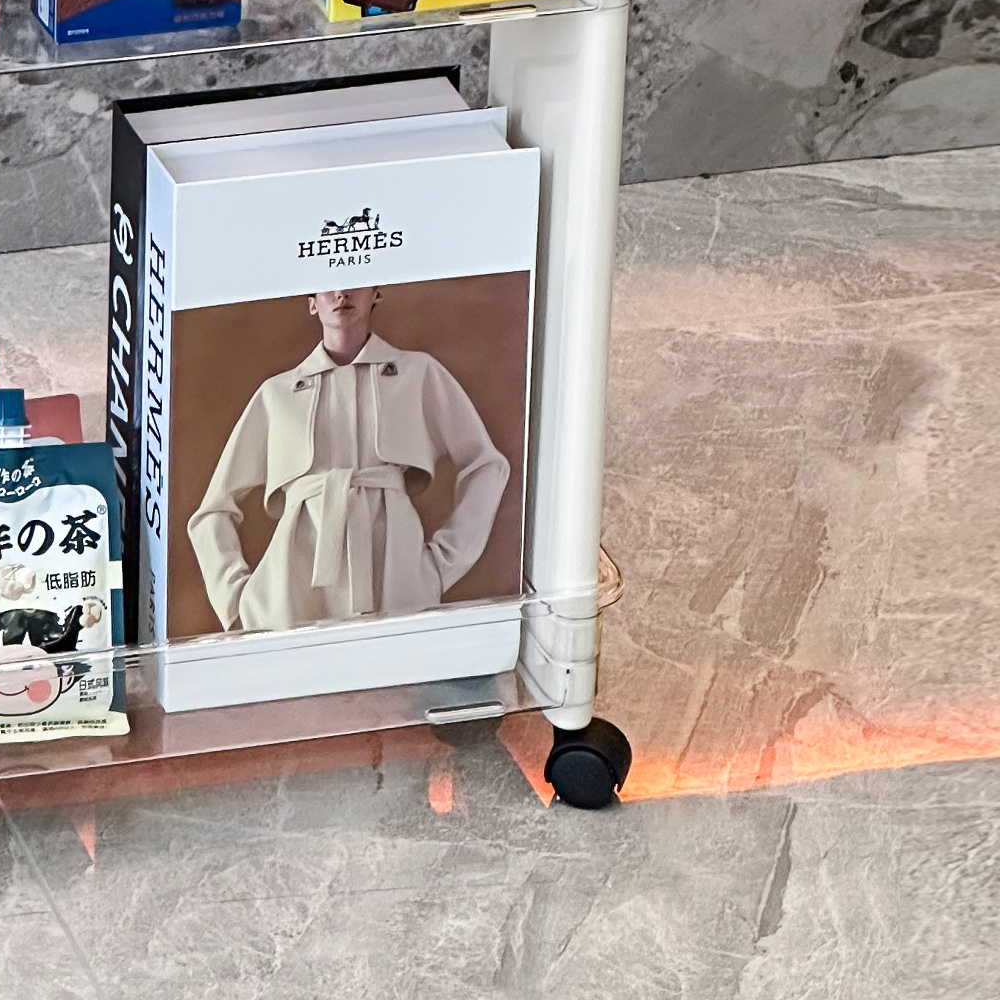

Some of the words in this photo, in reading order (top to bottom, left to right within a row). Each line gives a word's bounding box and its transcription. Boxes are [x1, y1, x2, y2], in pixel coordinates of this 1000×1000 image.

[328, 253, 372, 268] PARIS
[45, 570, 97, 590] 低脂肪
